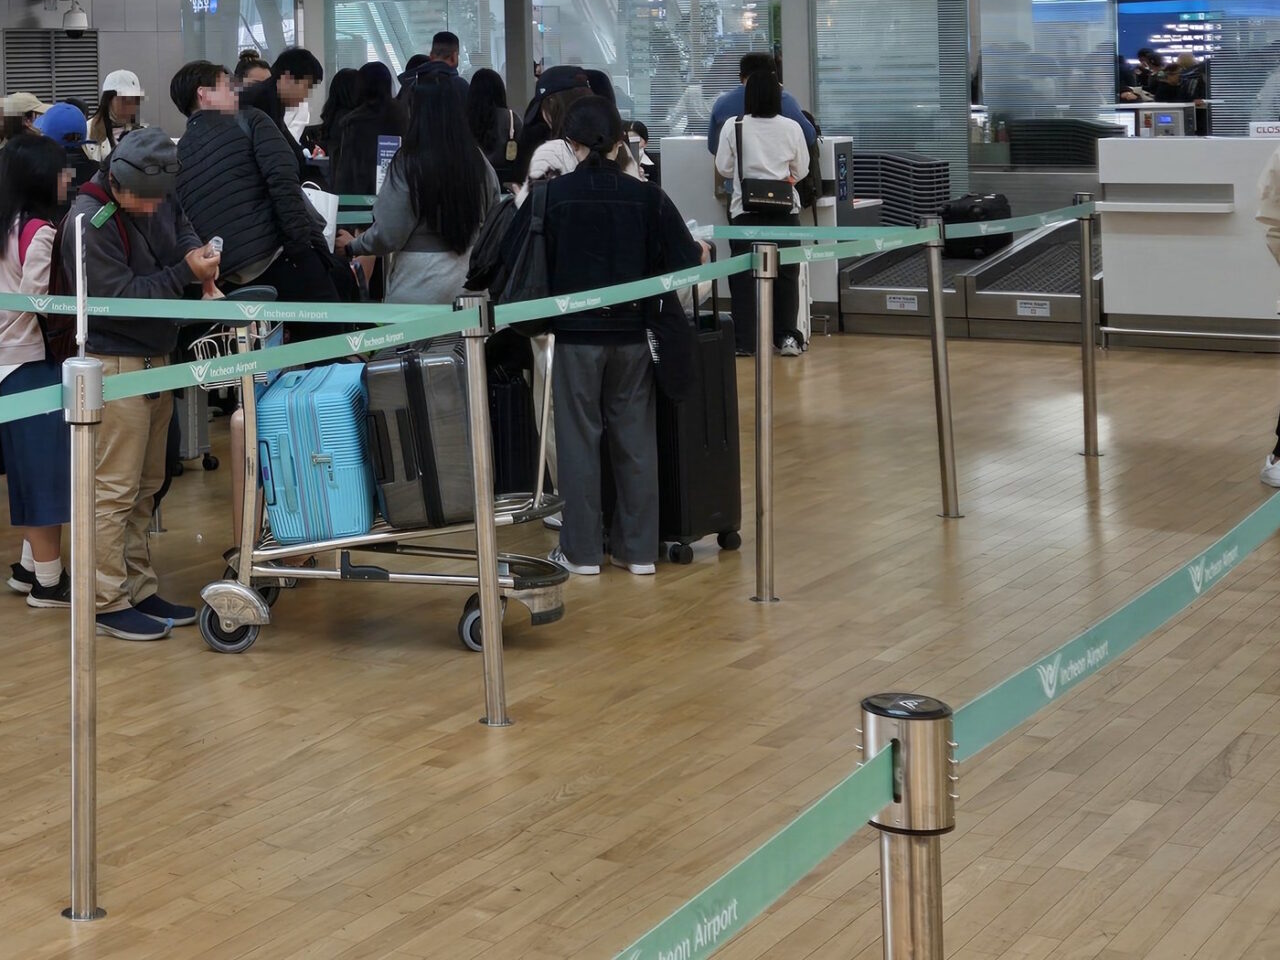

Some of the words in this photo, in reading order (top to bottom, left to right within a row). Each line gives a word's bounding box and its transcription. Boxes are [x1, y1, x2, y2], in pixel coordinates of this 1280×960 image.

[51, 302, 81, 312] Incheo
[82, 303, 110, 314] irport
[263, 308, 296, 319] Incheon
[298, 309, 328, 321] Airport
[364, 337, 385, 349] Incheon
[385, 331, 404, 344] Airport
[210, 365, 234, 378] Incheon
[235, 360, 257, 375] Airport
[694, 898, 739, 953] Airport
